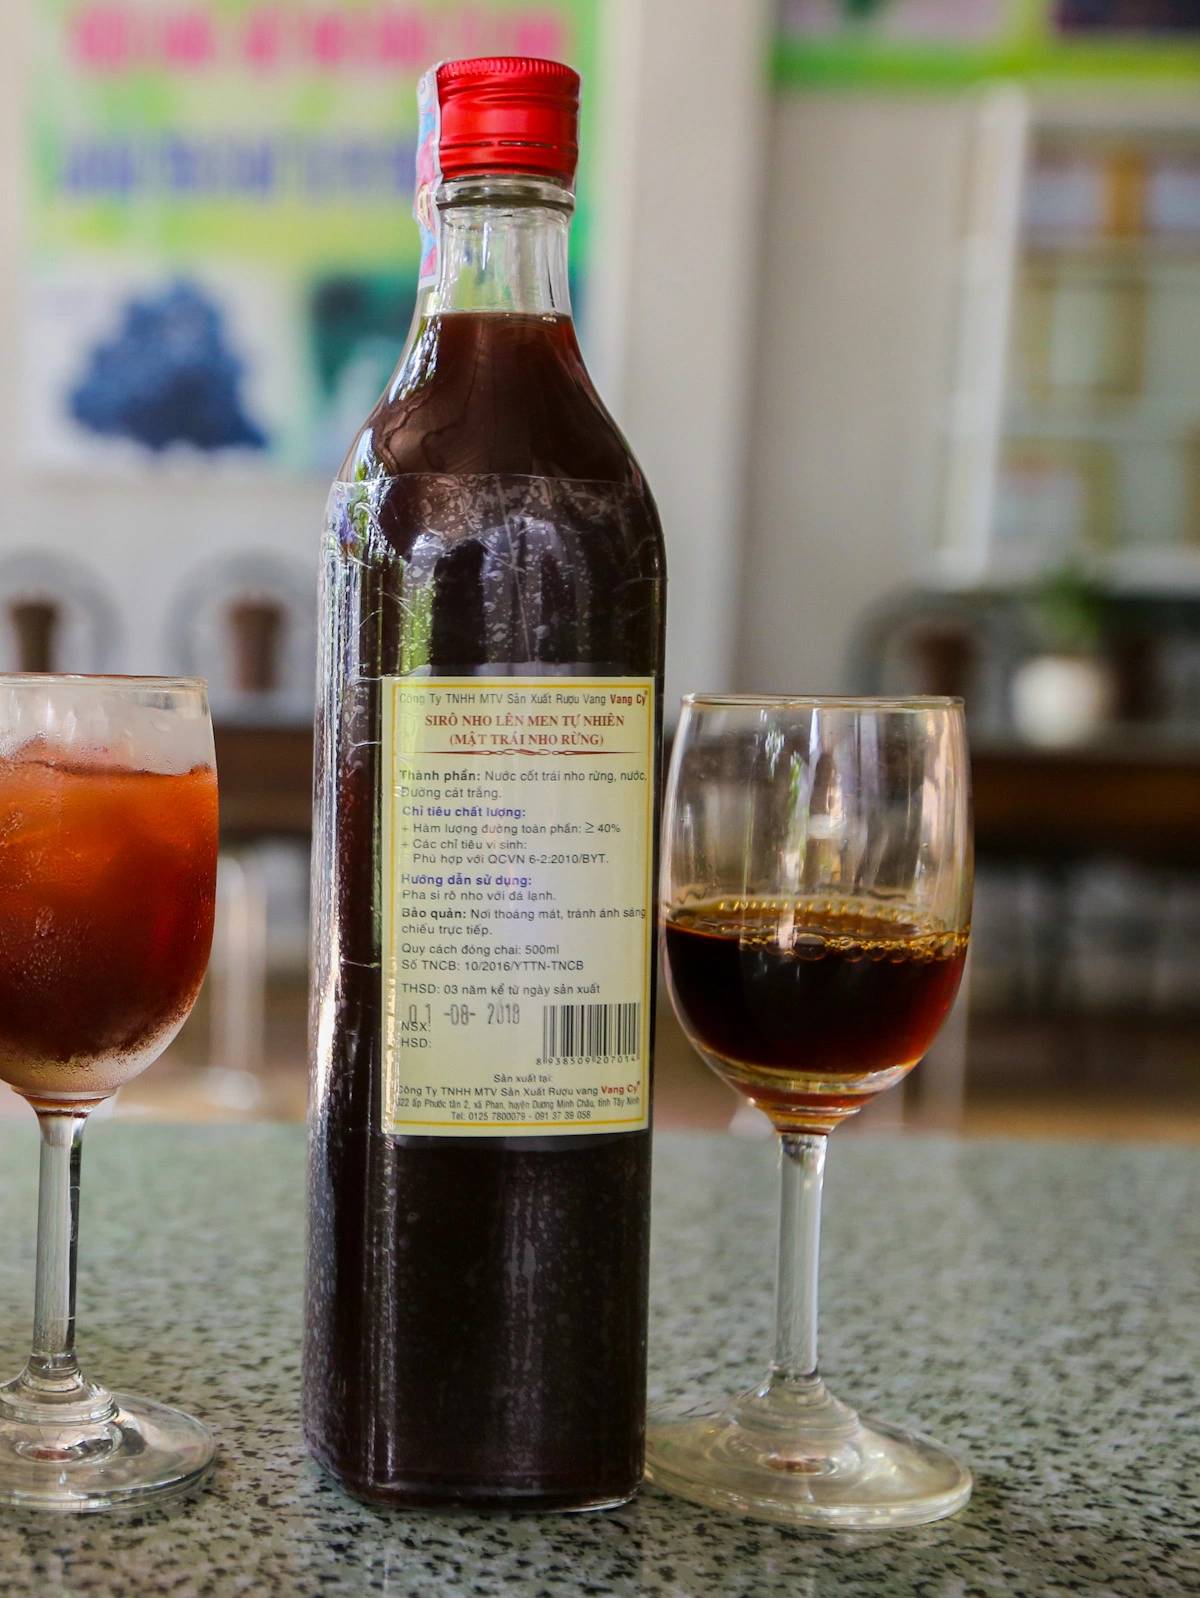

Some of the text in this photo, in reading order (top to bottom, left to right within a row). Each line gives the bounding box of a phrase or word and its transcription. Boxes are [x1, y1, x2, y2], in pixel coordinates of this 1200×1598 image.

[430, 693, 442, 706] Ty
[446, 693, 475, 704] TNHH
[480, 693, 502, 704] MTV
[507, 692, 526, 704] Sản
[531, 692, 552, 704] Xuất
[556, 693, 579, 705] Rượu
[583, 694, 606, 706] Vang
[610, 694, 632, 706] Vang
[425, 712, 625, 729] SIRÔ NHO LÊN MEN TỰ NHIÊN
[491, 731, 524, 746] TRÁI
[528, 734, 558, 746] NHO
[561, 731, 604, 746] RỪNG)
[400, 769, 439, 781] Thành
[485, 771, 516, 782] Nước
[520, 769, 538, 782] cốt
[542, 770, 560, 782] trái
[564, 771, 585, 781] nho
[588, 771, 617, 784] rừng,
[445, 787, 464, 798] cát
[402, 805, 526, 820] Chỉ tiêu chất lượng:
[413, 823, 441, 834] Hàm
[445, 823, 478, 836] lượng
[481, 823, 519, 836] đường
[522, 824, 546, 834] toàn
[598, 823, 621, 833] 40%
[413, 839, 437, 850] Các
[440, 838, 458, 850] chỉ
[461, 839, 483, 850] tiêu
[486, 841, 496, 850] vi
[499, 840, 527, 850] sinh:
[413, 853, 437, 864] Phù
[440, 853, 464, 866] hợp
[466, 854, 485, 864] với
[488, 853, 525, 865] QCVN
[401, 872, 532, 888] Hướng dẫn sử dụng:
[402, 889, 426, 900] Pha
[430, 891, 440, 901] si
[460, 890, 484, 901] nho
[487, 890, 505, 901] với
[508, 890, 524, 901] đá
[402, 906, 427, 919] Bảo
[471, 908, 491, 919] Nơi
[494, 909, 535, 922] thoáng
[567, 908, 596, 919] tránh
[599, 908, 620, 919] ánh
[439, 925, 463, 937] trực
[466, 924, 493, 937] tiếp.
[402, 943, 560, 957] Quy cách đóng chai: 500ml
[401, 958, 585, 972] Số TNCB: 10/2016/YTTN-TNCB
[401, 982, 601, 998] THSD: 03 năm kể từ ngày sản xuất
[487, 1003, 520, 1025] 2018
[400, 1021, 431, 1033] NSX:
[400, 1037, 431, 1049] HSD:
[493, 1073, 513, 1084] Sản
[516, 1073, 536, 1083] xuất
[425, 1086, 438, 1097] Ty
[441, 1086, 471, 1097] TNHH
[474, 1087, 498, 1097] MTV
[500, 1086, 520, 1097] Sản
[523, 1086, 546, 1097] Xuất
[548, 1087, 574, 1098] Rượu
[576, 1087, 599, 1097] vang
[601, 1085, 625, 1096] Vang
[556, 1099, 574, 1109] Minh
[468, 1112, 489, 1121] 0125
